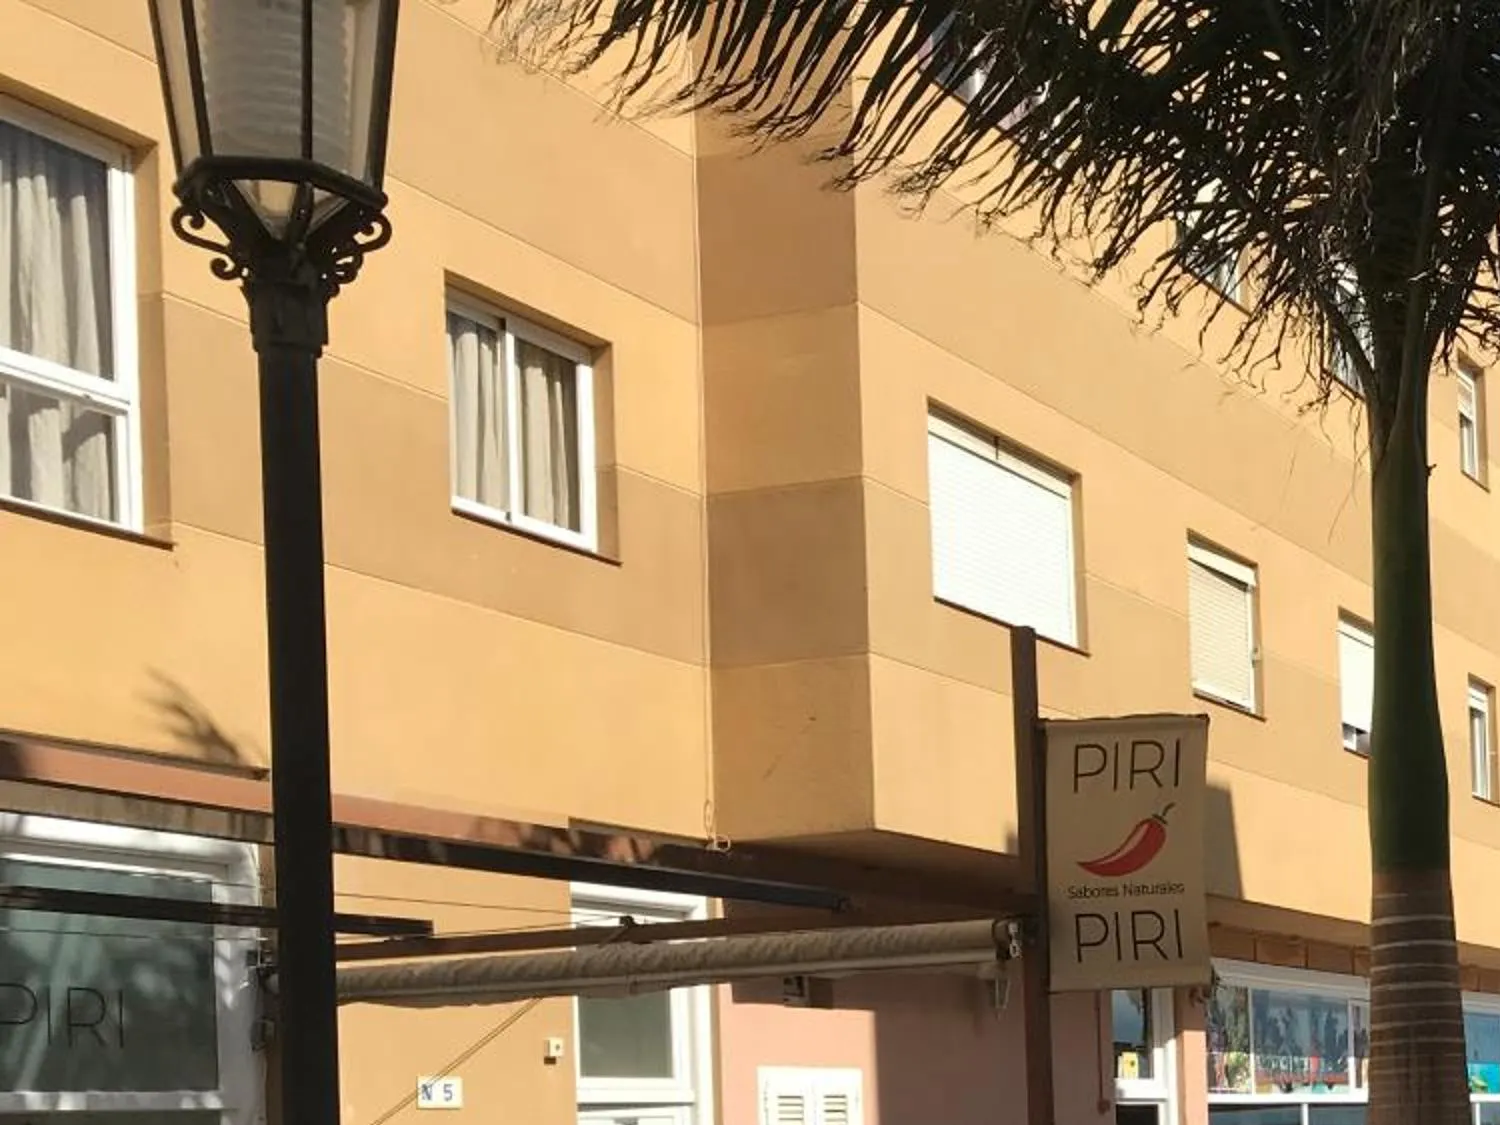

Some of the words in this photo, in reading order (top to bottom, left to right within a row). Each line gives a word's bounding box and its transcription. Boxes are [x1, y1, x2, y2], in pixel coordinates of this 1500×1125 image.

[1073, 738, 1181, 793] PIRI
[1067, 884, 1119, 899] Sabores
[1122, 881, 1185, 898] Naturales
[1074, 908, 1184, 963] PIRI
[443, 1083, 453, 1102] 5
